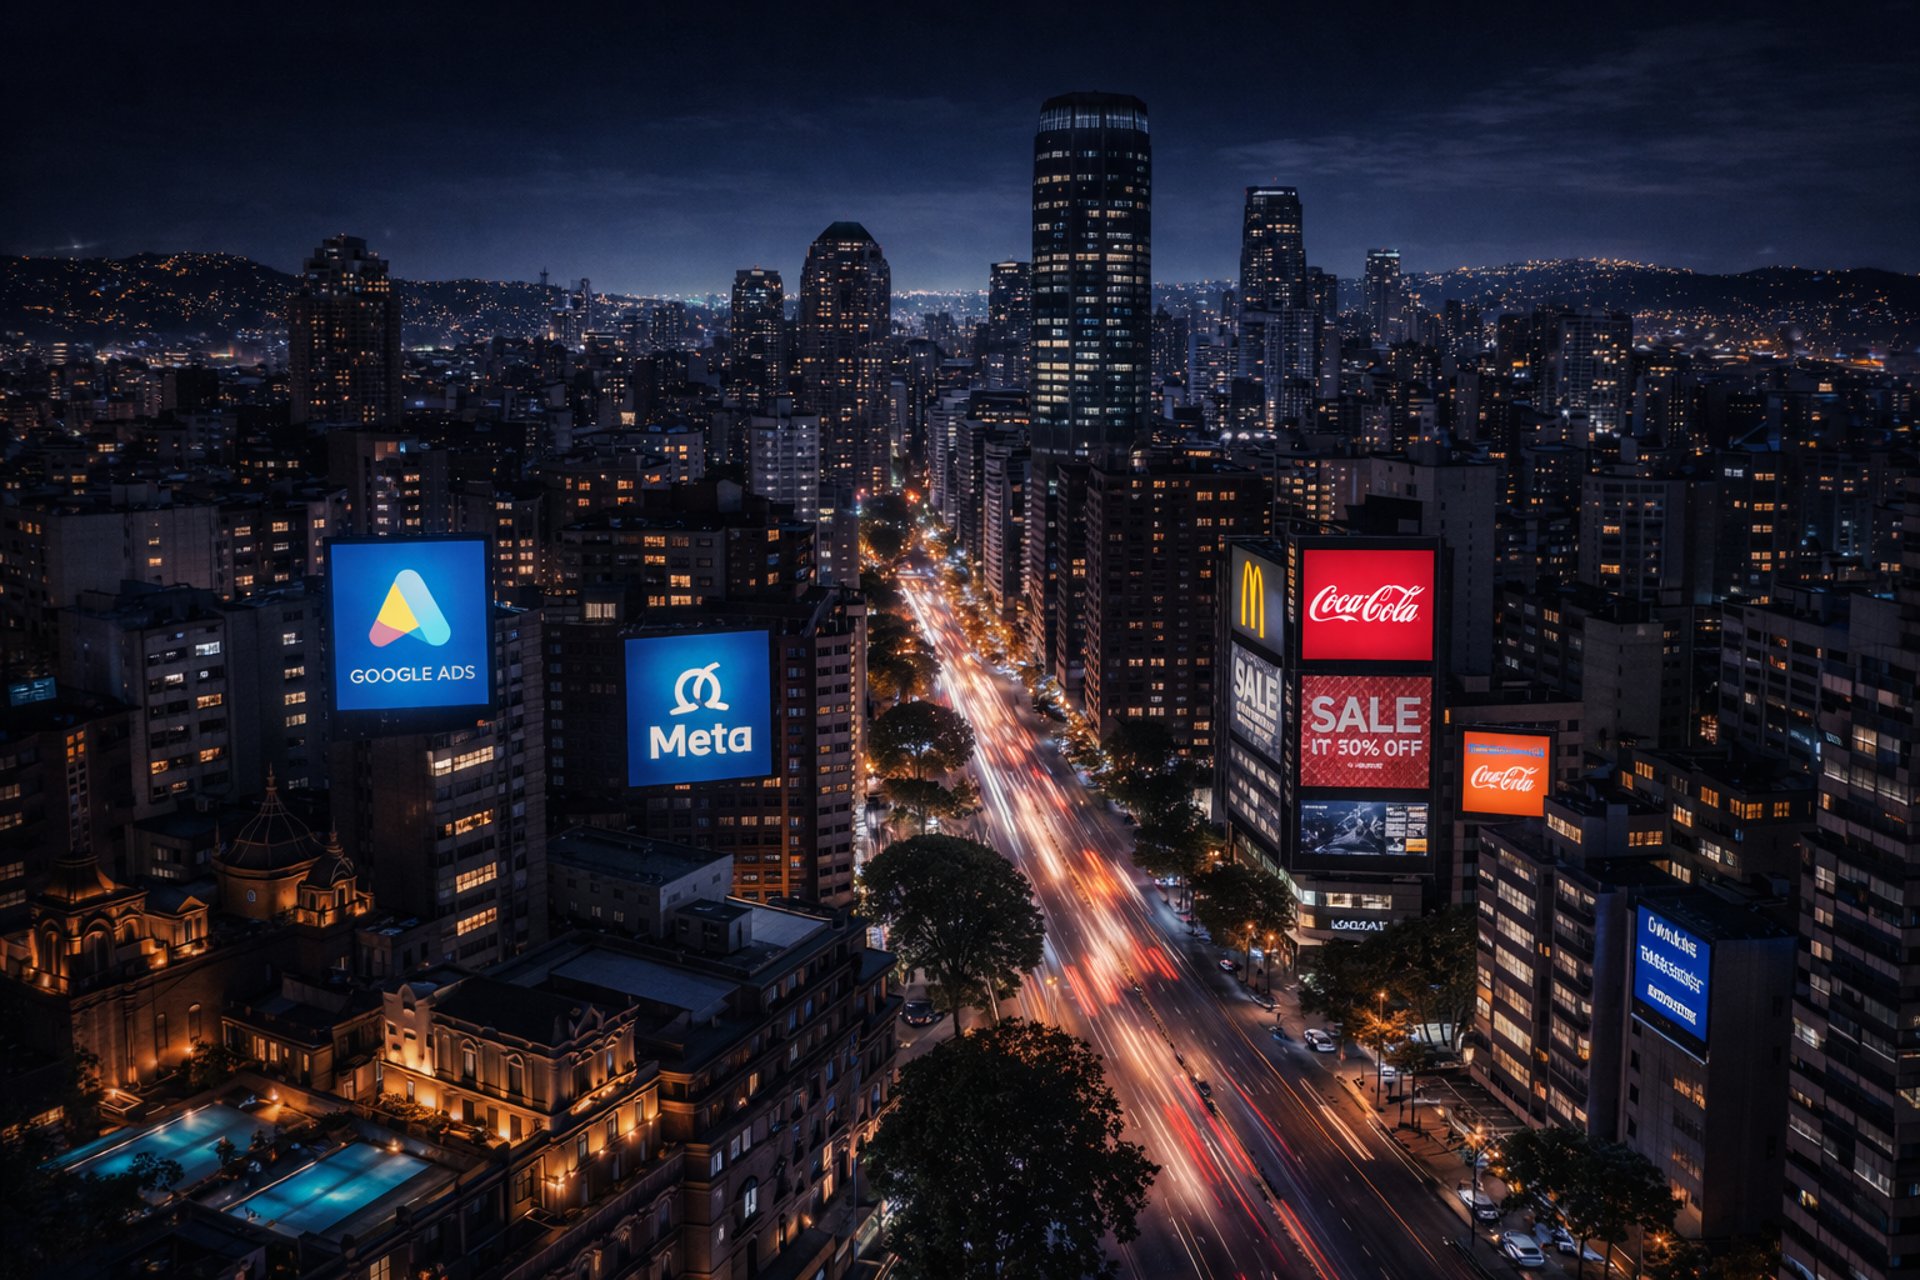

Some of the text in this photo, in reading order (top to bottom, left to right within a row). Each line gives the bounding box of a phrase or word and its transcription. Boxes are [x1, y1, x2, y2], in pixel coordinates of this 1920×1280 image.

[1309, 584, 1425, 623] Coca-Cola
[350, 665, 476, 684] GOOGLE ADS
[1233, 657, 1277, 721] SALE
[1311, 695, 1422, 734] SALE
[650, 723, 752, 760] Meta
[1384, 739, 1423, 757] OFF
